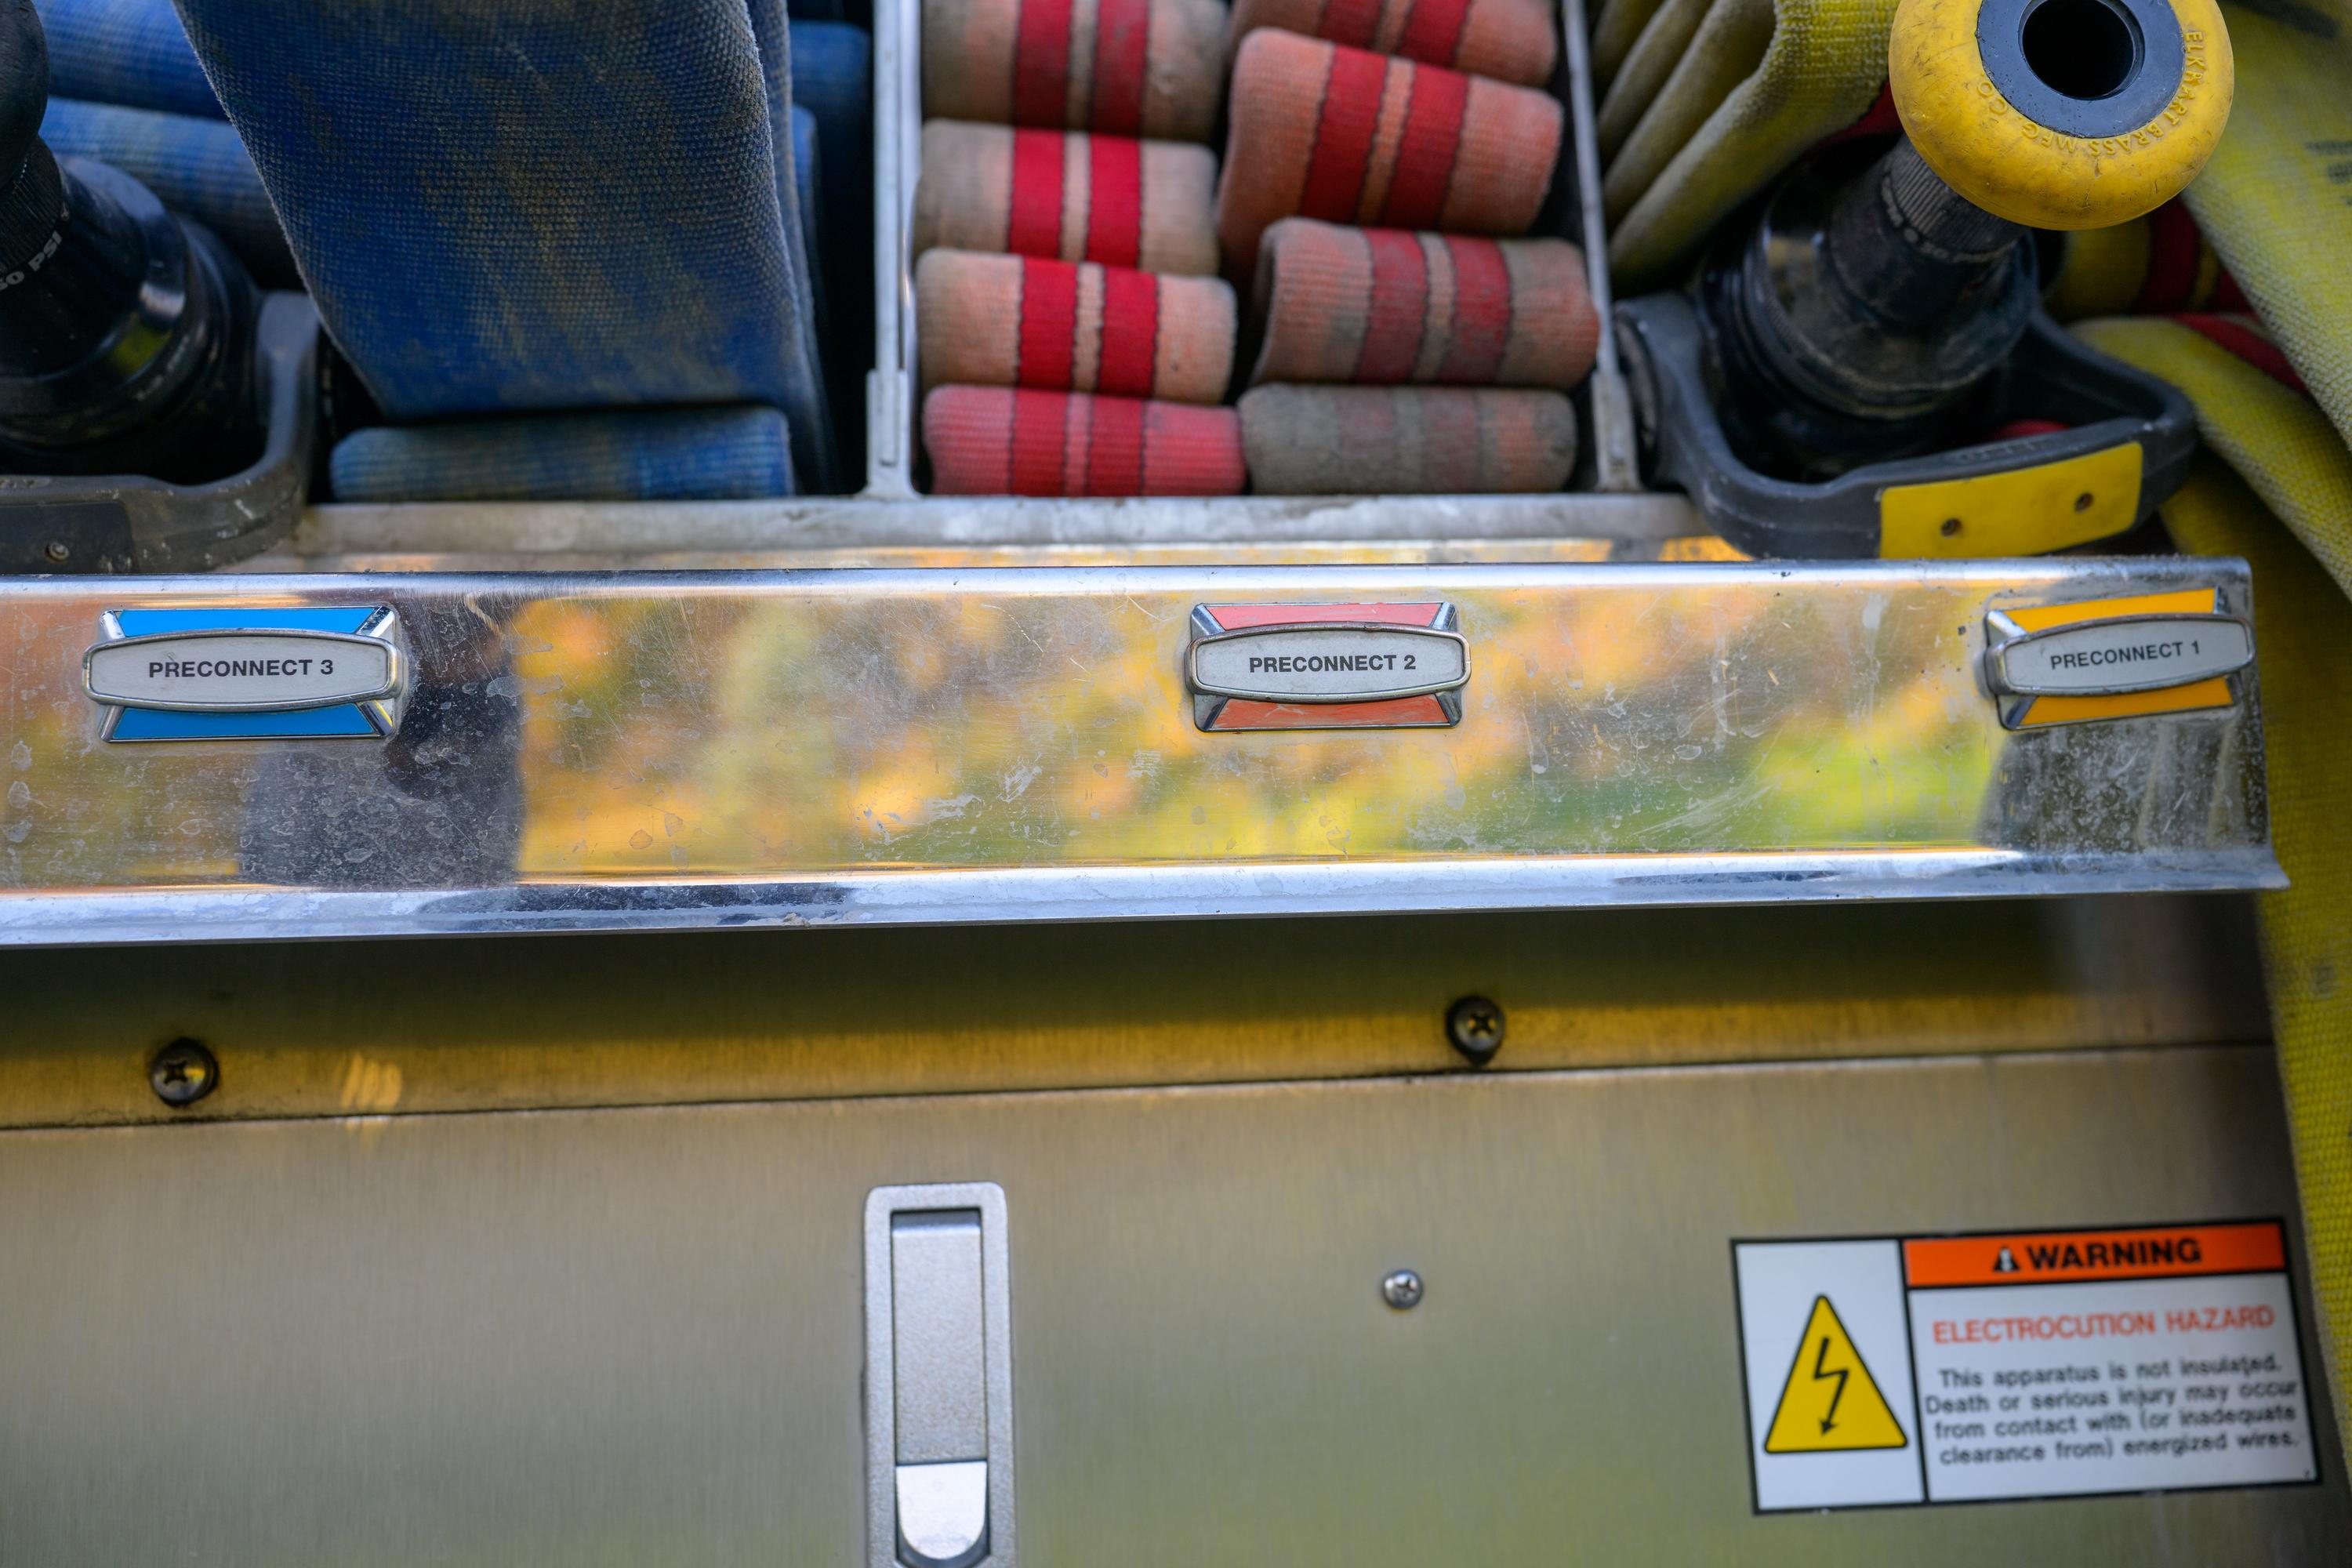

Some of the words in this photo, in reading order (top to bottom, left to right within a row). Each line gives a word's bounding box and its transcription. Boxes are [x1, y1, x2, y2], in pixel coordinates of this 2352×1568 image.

[2089, 122, 2165, 157] BRASS
[27, 230, 62, 272] PSI
[149, 659, 313, 678] PRECONNECT
[320, 659, 334, 675] 3
[1249, 655, 1397, 673] PRECONNECT
[1403, 655, 1417, 670] 2
[2049, 641, 2183, 670] PRECONNECT
[2190, 641, 2200, 655] 1
[2026, 1238, 2202, 1270] WARNING
[1933, 1312, 2155, 1345] ELECTROCUTION
[2165, 1305, 2275, 1333] HAZARD
[1939, 1368, 1984, 1388] This
[1993, 1365, 2100, 1388] apparatus
[2108, 1360, 2127, 1380] is
[2136, 1359, 2170, 1377] not
[2180, 1354, 2281, 1377] insulated.
[1925, 1395, 1990, 1414] Death
[1998, 1396, 2020, 1410] or
[2031, 1389, 2109, 1410] serious
[2118, 1386, 2176, 1406] injury
[2184, 1385, 2229, 1403] may
[2238, 1381, 2297, 1398] occur
[1933, 1420, 1985, 1439] from
[1994, 1416, 2077, 1437] contact
[2085, 1413, 2131, 1433] with
[2139, 1409, 2169, 1432] (or
[2180, 1405, 2297, 1427] inadequate
[1939, 1443, 2046, 1466] clearance
[2055, 1436, 2114, 1460] from)
[2122, 1432, 2227, 1457] energized
[2237, 1430, 2299, 1450] wires.
